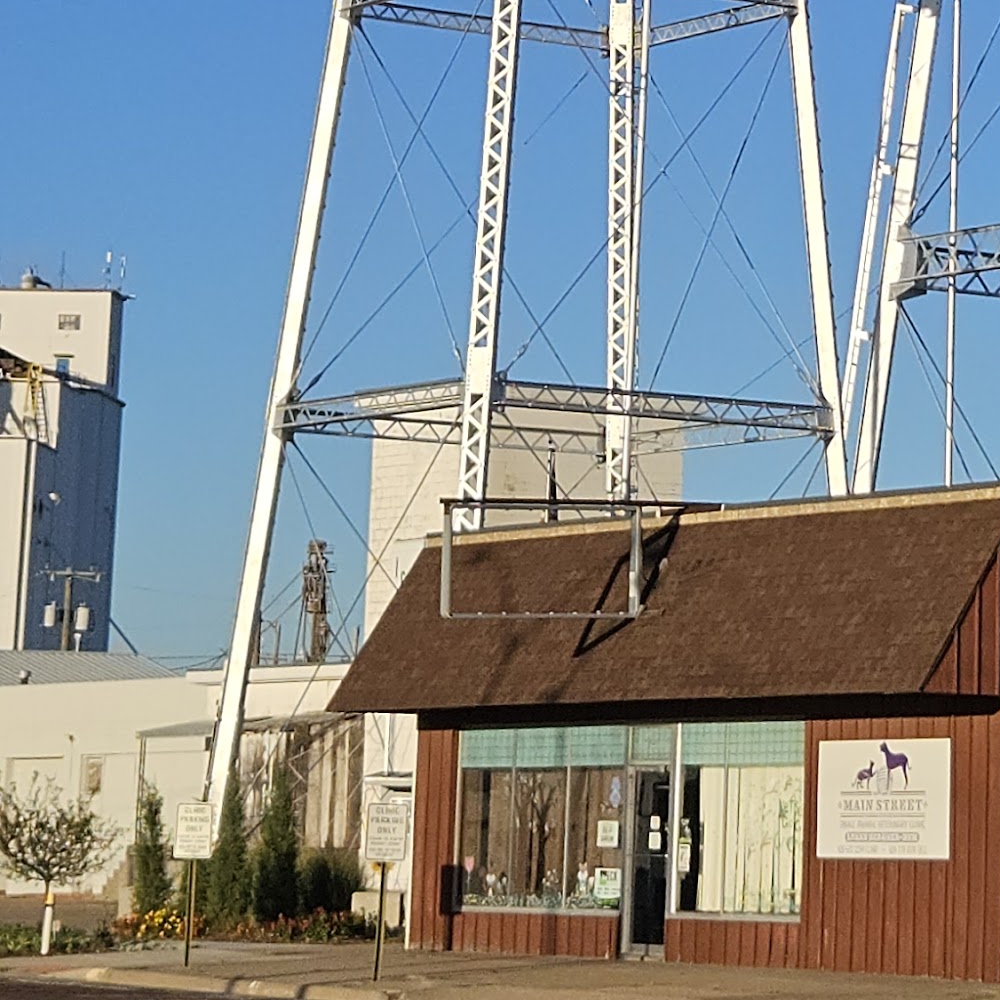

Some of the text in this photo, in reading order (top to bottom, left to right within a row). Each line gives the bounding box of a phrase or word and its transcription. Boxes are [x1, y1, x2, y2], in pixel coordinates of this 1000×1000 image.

[843, 799, 923, 811] MAIN STREET
[376, 826, 397, 834] ONLY
